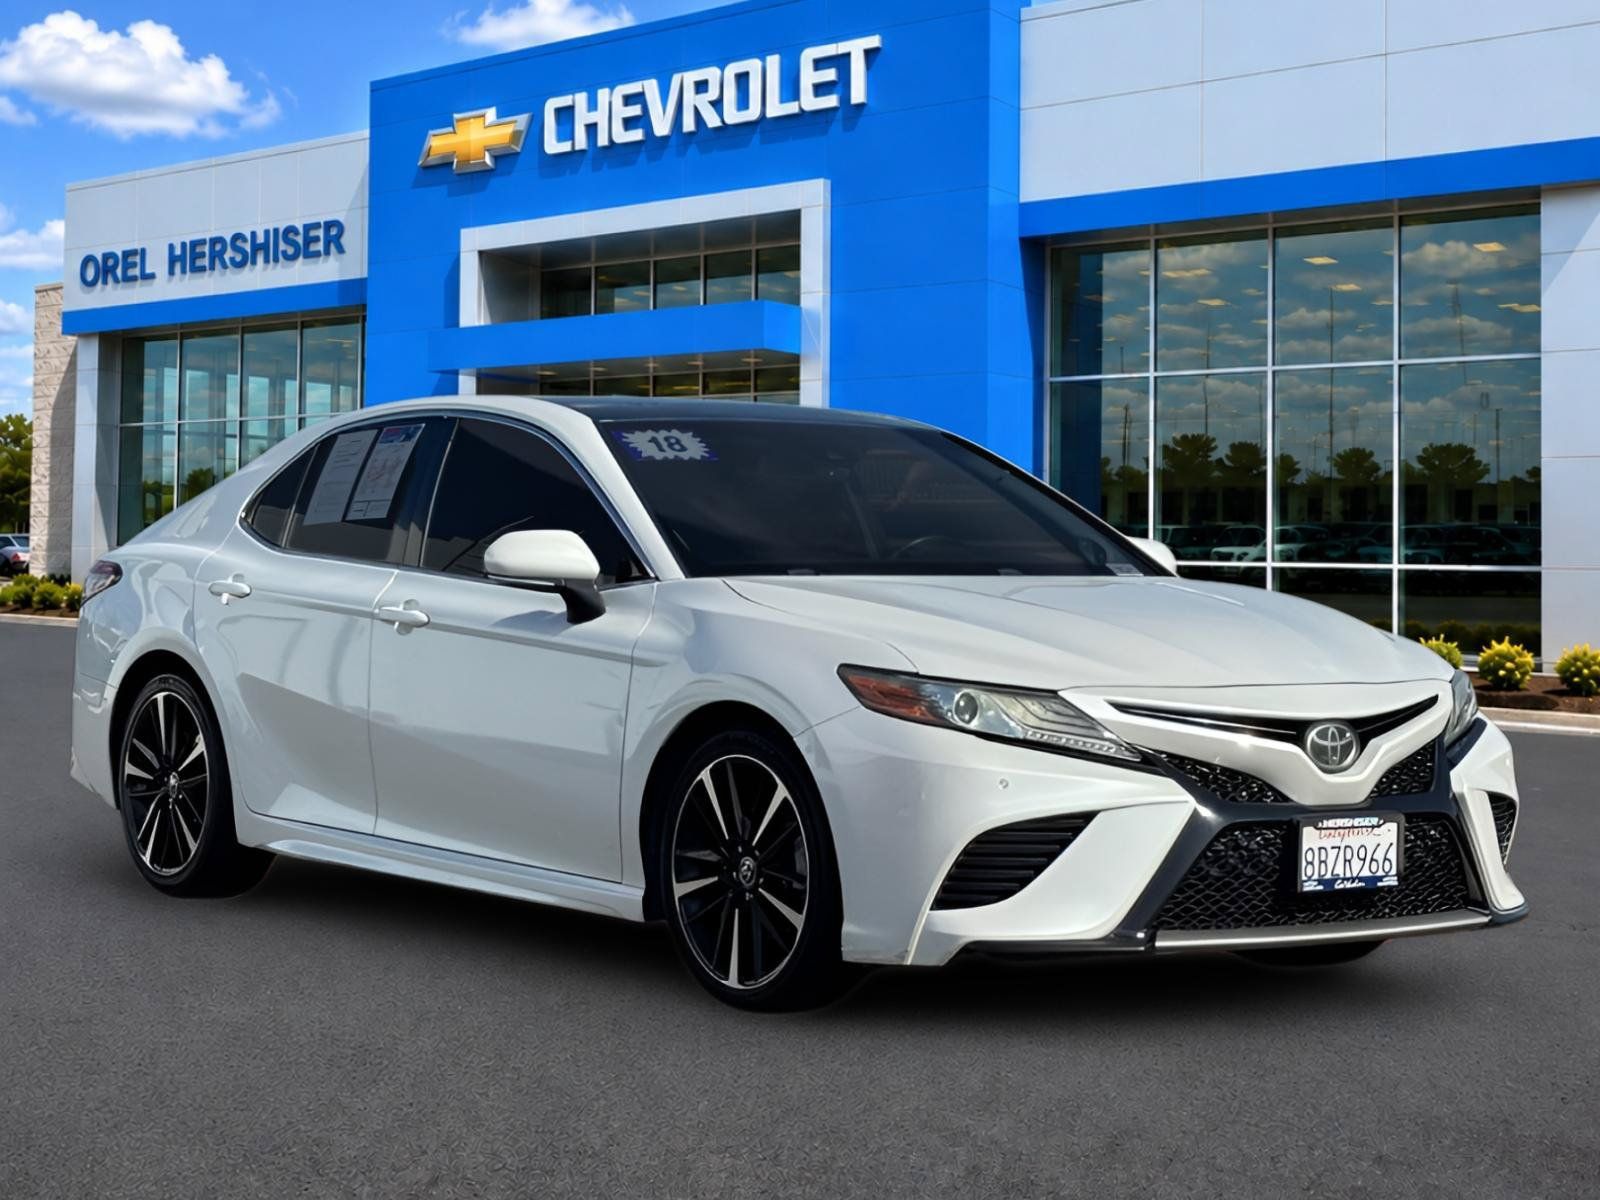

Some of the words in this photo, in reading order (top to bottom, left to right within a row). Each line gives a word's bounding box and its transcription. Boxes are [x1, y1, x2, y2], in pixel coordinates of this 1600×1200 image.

[543, 34, 882, 155] CHEVROLET
[79, 247, 156, 287] OREL
[167, 219, 346, 276] HERSHISER
[648, 435, 688, 452] 18
[1304, 842, 1393, 879] 8BZR966
